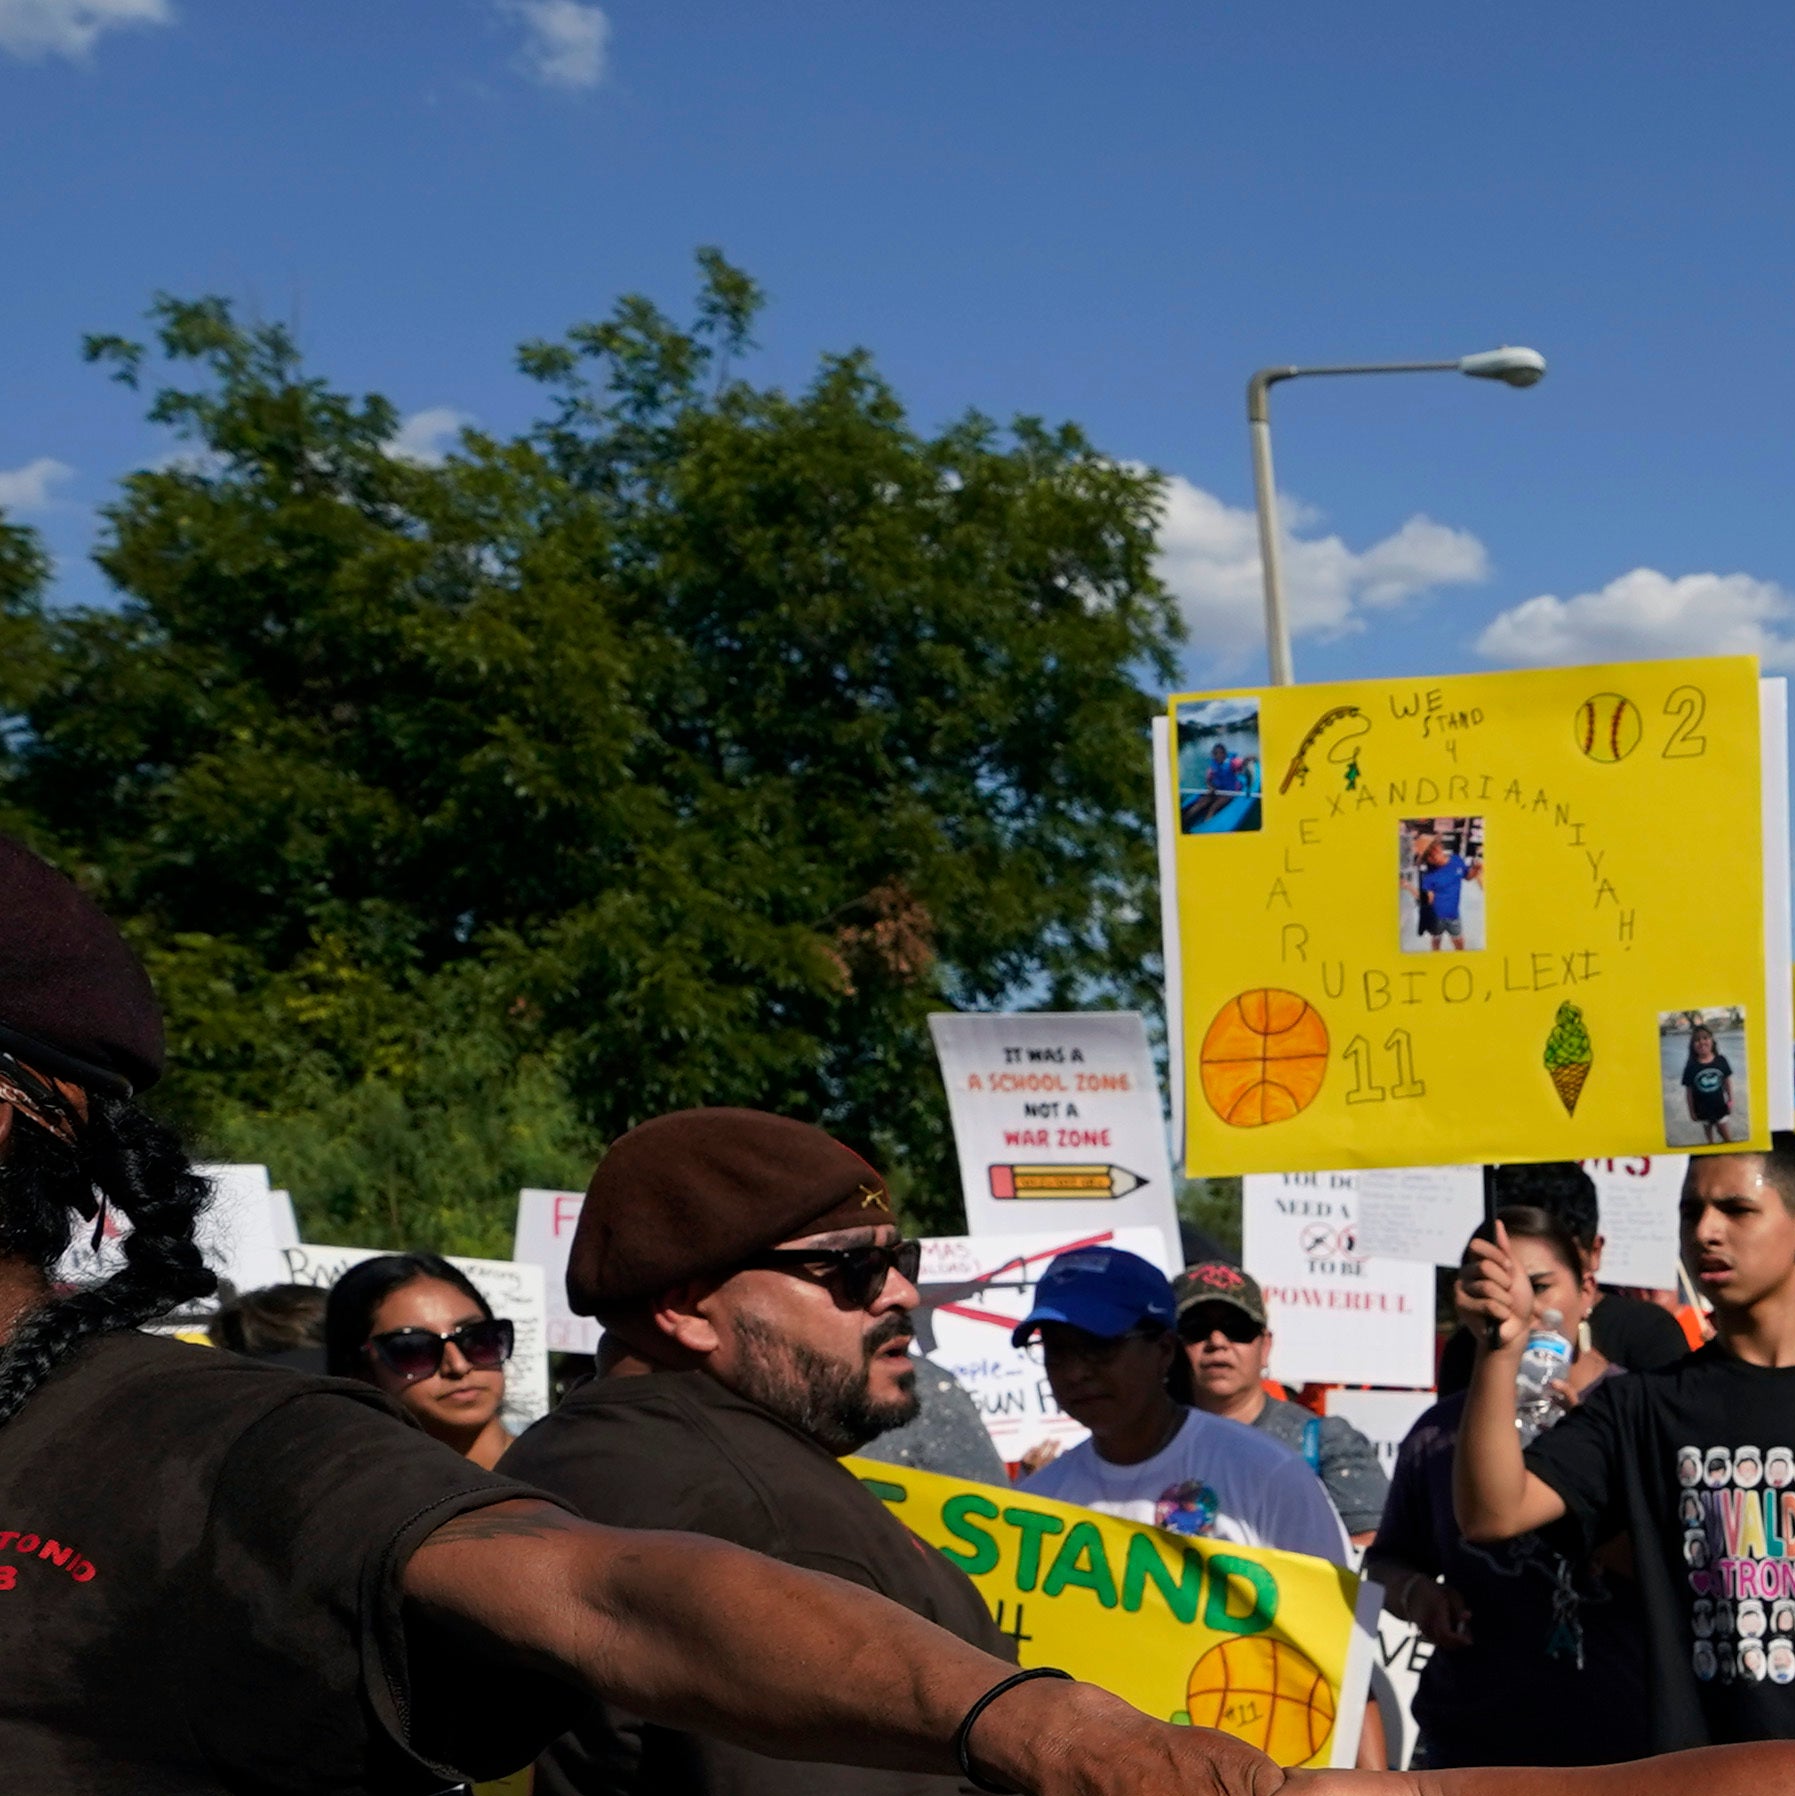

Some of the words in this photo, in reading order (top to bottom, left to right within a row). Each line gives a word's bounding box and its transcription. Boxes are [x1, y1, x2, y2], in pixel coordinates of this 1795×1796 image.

[1389, 688, 1444, 721] WE
[1421, 708, 1485, 738] STAND
[1661, 685, 1708, 759] 2
[1444, 739, 1458, 764] 4
[1003, 1047, 1023, 1064] IT
[1027, 1046, 1065, 1064] WAS
[1070, 1047, 1085, 1063] A
[1342, 1027, 1426, 1107] 11
[967, 1072, 983, 1091] A
[988, 1072, 1068, 1092] SCHOOL
[1074, 1072, 1130, 1092] ZONE
[1024, 1102, 1059, 1118] NOT
[1066, 1102, 1079, 1118] A
[1003, 1129, 1049, 1147] WAR
[1056, 1128, 1111, 1147] ZONE
[1275, 1198, 1331, 1218] NEED
[1307, 1260, 1336, 1276] TO
[1340, 1261, 1367, 1277] BE
[1262, 1286, 1414, 1314] POWERFUL
[941, 1493, 1280, 1636] STAND
